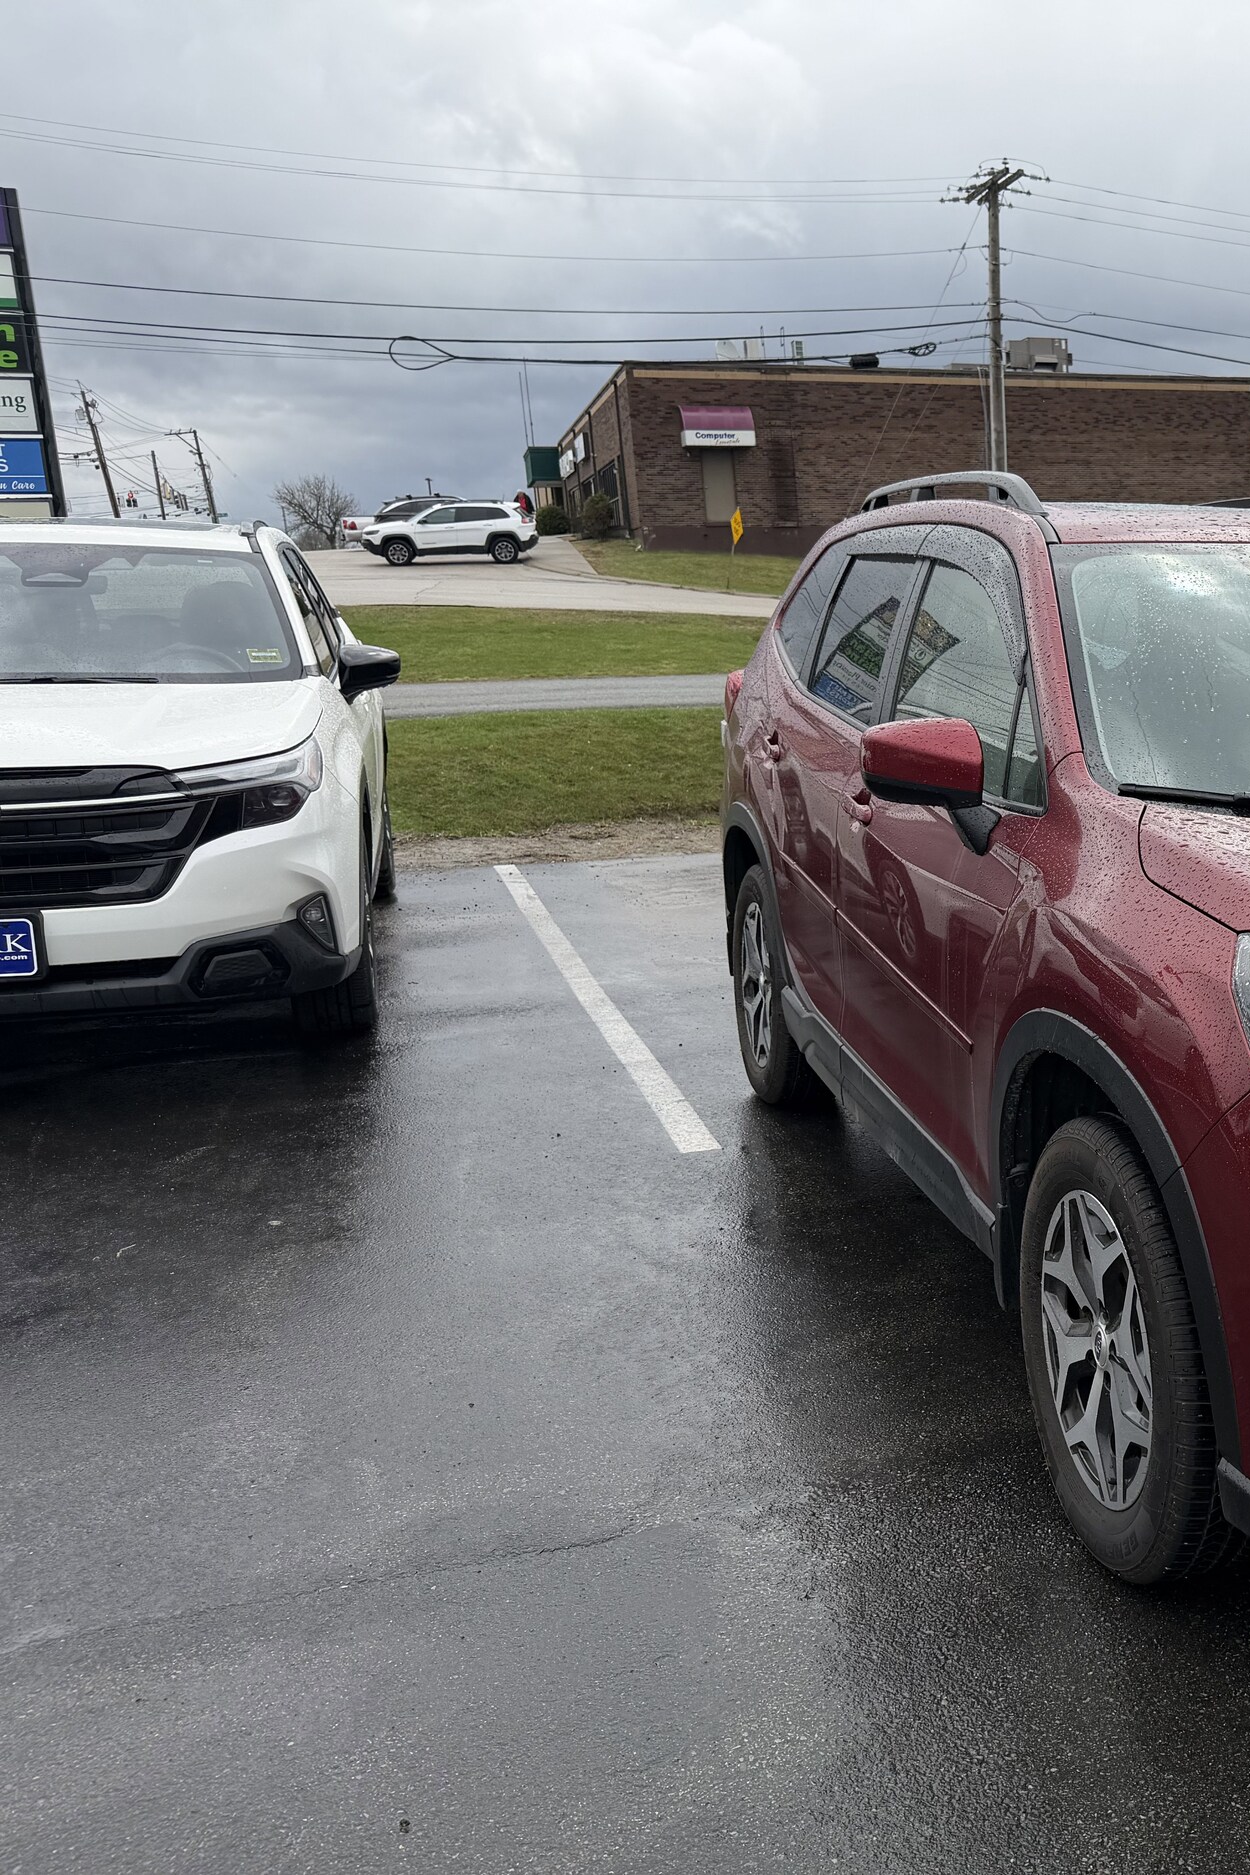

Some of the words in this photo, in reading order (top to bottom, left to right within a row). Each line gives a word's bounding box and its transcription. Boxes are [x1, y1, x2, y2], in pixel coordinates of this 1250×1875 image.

[1, 396, 27, 413] ng
[695, 431, 736, 441] Computer
[0, 933, 32, 953] K
